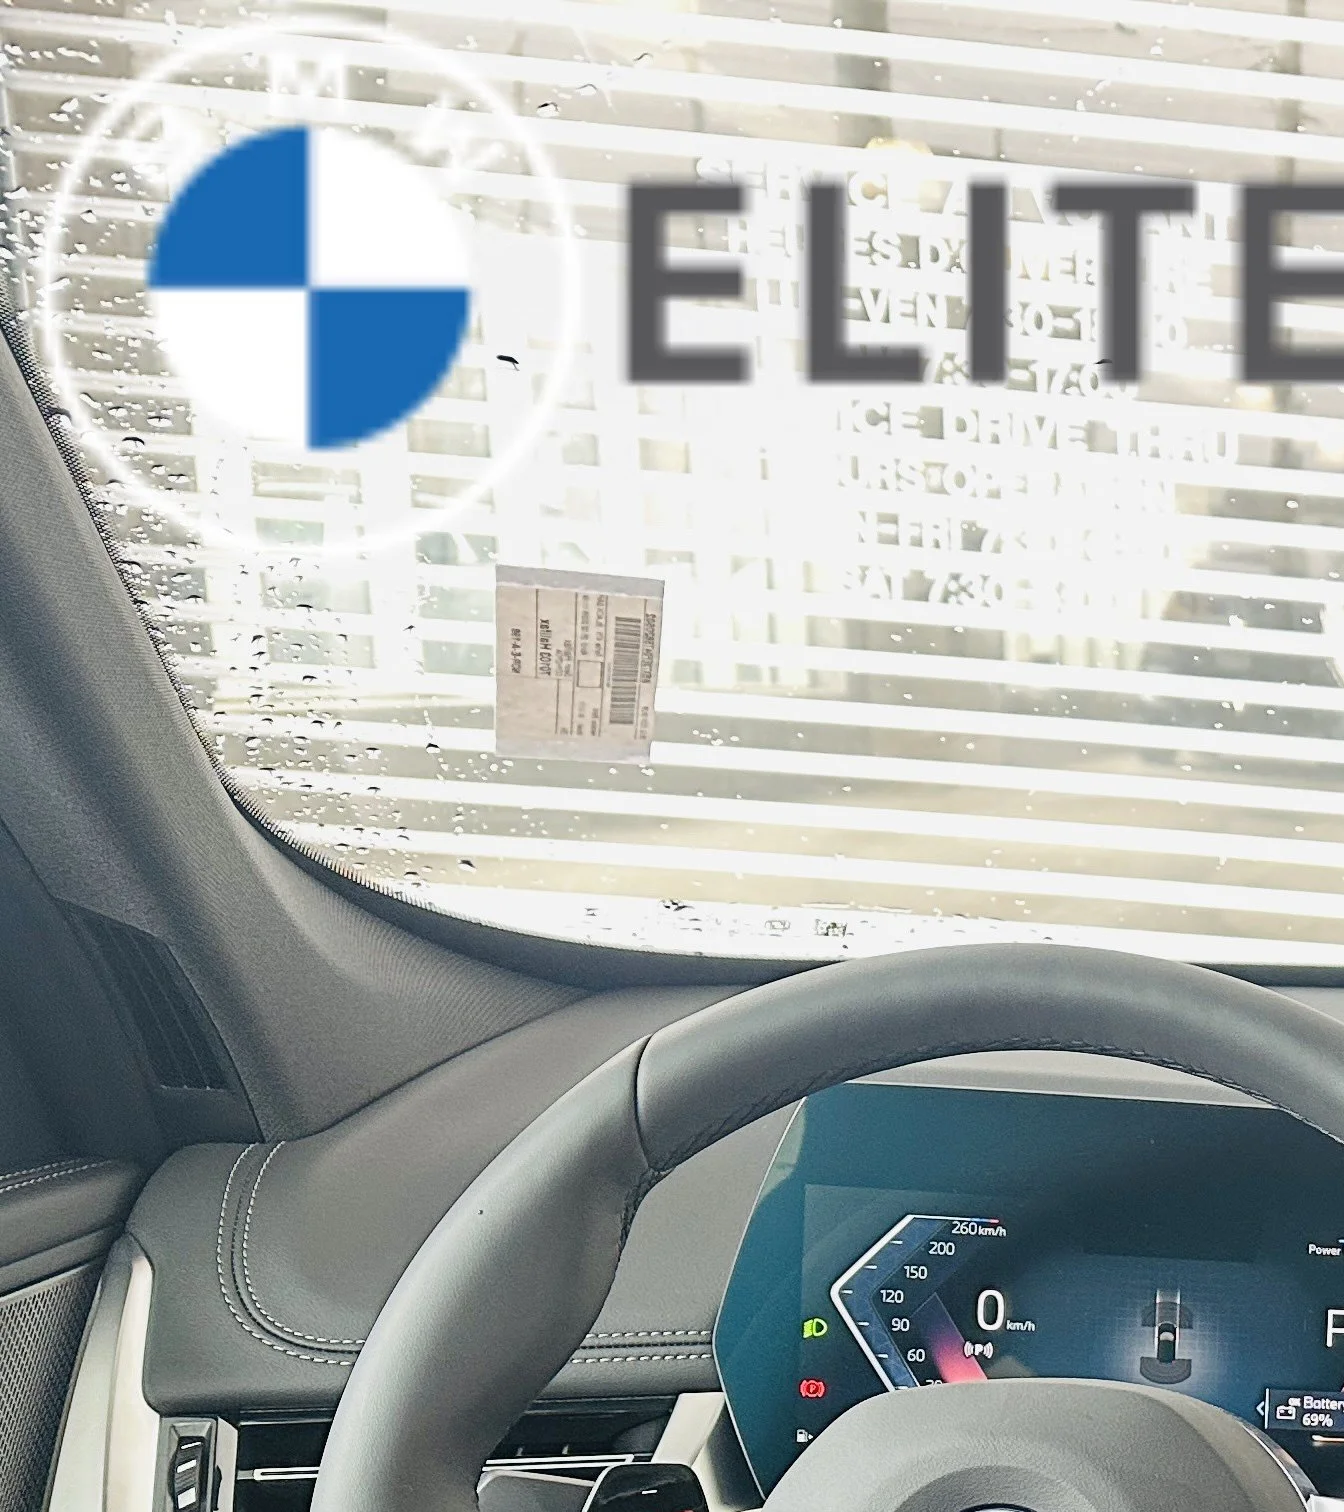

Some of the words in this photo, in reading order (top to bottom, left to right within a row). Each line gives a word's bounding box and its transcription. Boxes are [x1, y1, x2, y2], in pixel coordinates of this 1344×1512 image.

[952, 1221, 977, 1235] 260
[978, 1226, 1006, 1238] km/h
[929, 1242, 955, 1256] 200
[1308, 1244, 1341, 1256] Power
[904, 1266, 928, 1280] 150
[880, 1290, 904, 1304] 120
[977, 1290, 1005, 1331] 0
[1006, 1320, 1036, 1332] km/h
[891, 1318, 910, 1332] 90
[907, 1349, 925, 1363] 60
[1302, 1413, 1334, 1428] 69%
